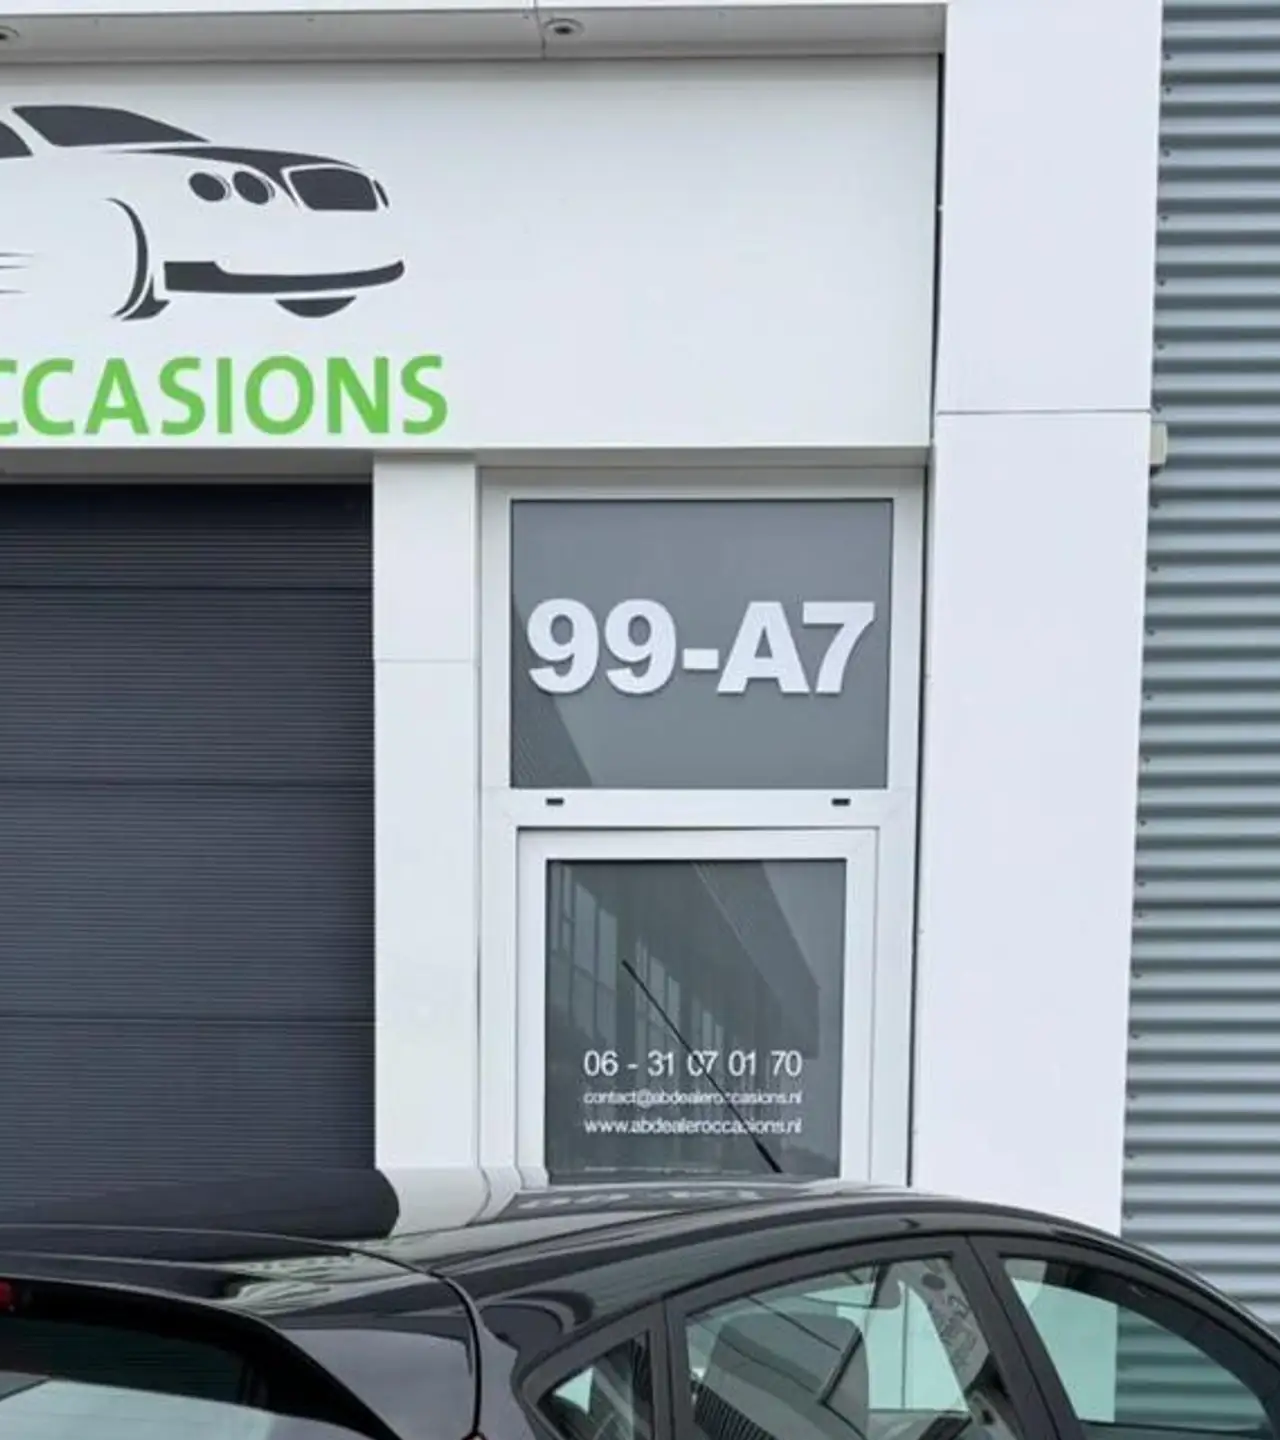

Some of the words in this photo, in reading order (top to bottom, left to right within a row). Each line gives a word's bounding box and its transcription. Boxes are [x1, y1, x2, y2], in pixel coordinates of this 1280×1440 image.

[526, 597, 876, 696] 99-A7
[583, 1049, 619, 1077] 06
[647, 1049, 675, 1077] 31
[686, 1050, 719, 1077] 07
[727, 1050, 757, 1077] 01
[771, 1050, 803, 1077] 70
[583, 1117, 802, 1135] www.abdealeroccasions.nl
